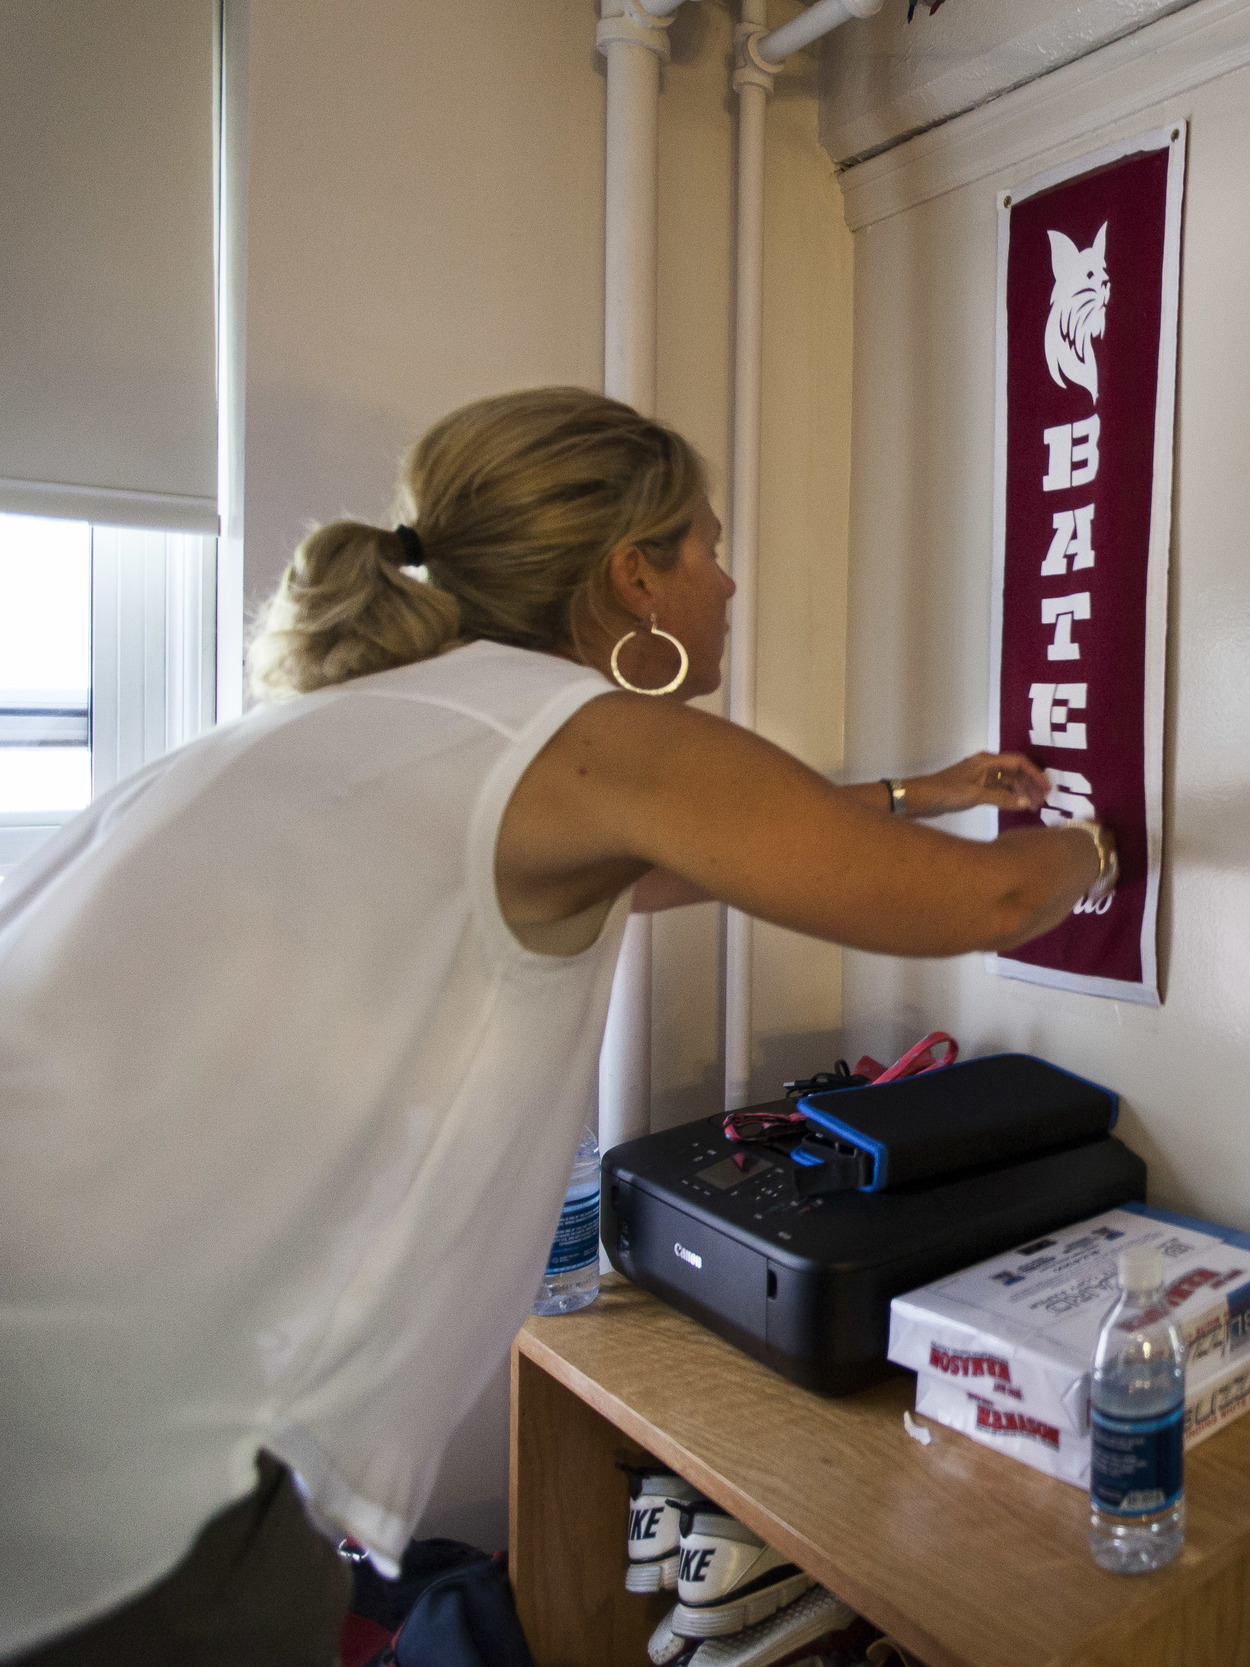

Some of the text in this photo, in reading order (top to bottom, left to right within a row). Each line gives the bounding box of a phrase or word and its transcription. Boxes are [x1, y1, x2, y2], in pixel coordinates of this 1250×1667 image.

[1028, 414, 1101, 827] BATES
[673, 1241, 703, 1269] Canon
[628, 1506, 665, 1541] IKE
[678, 1547, 717, 1583] IKE
